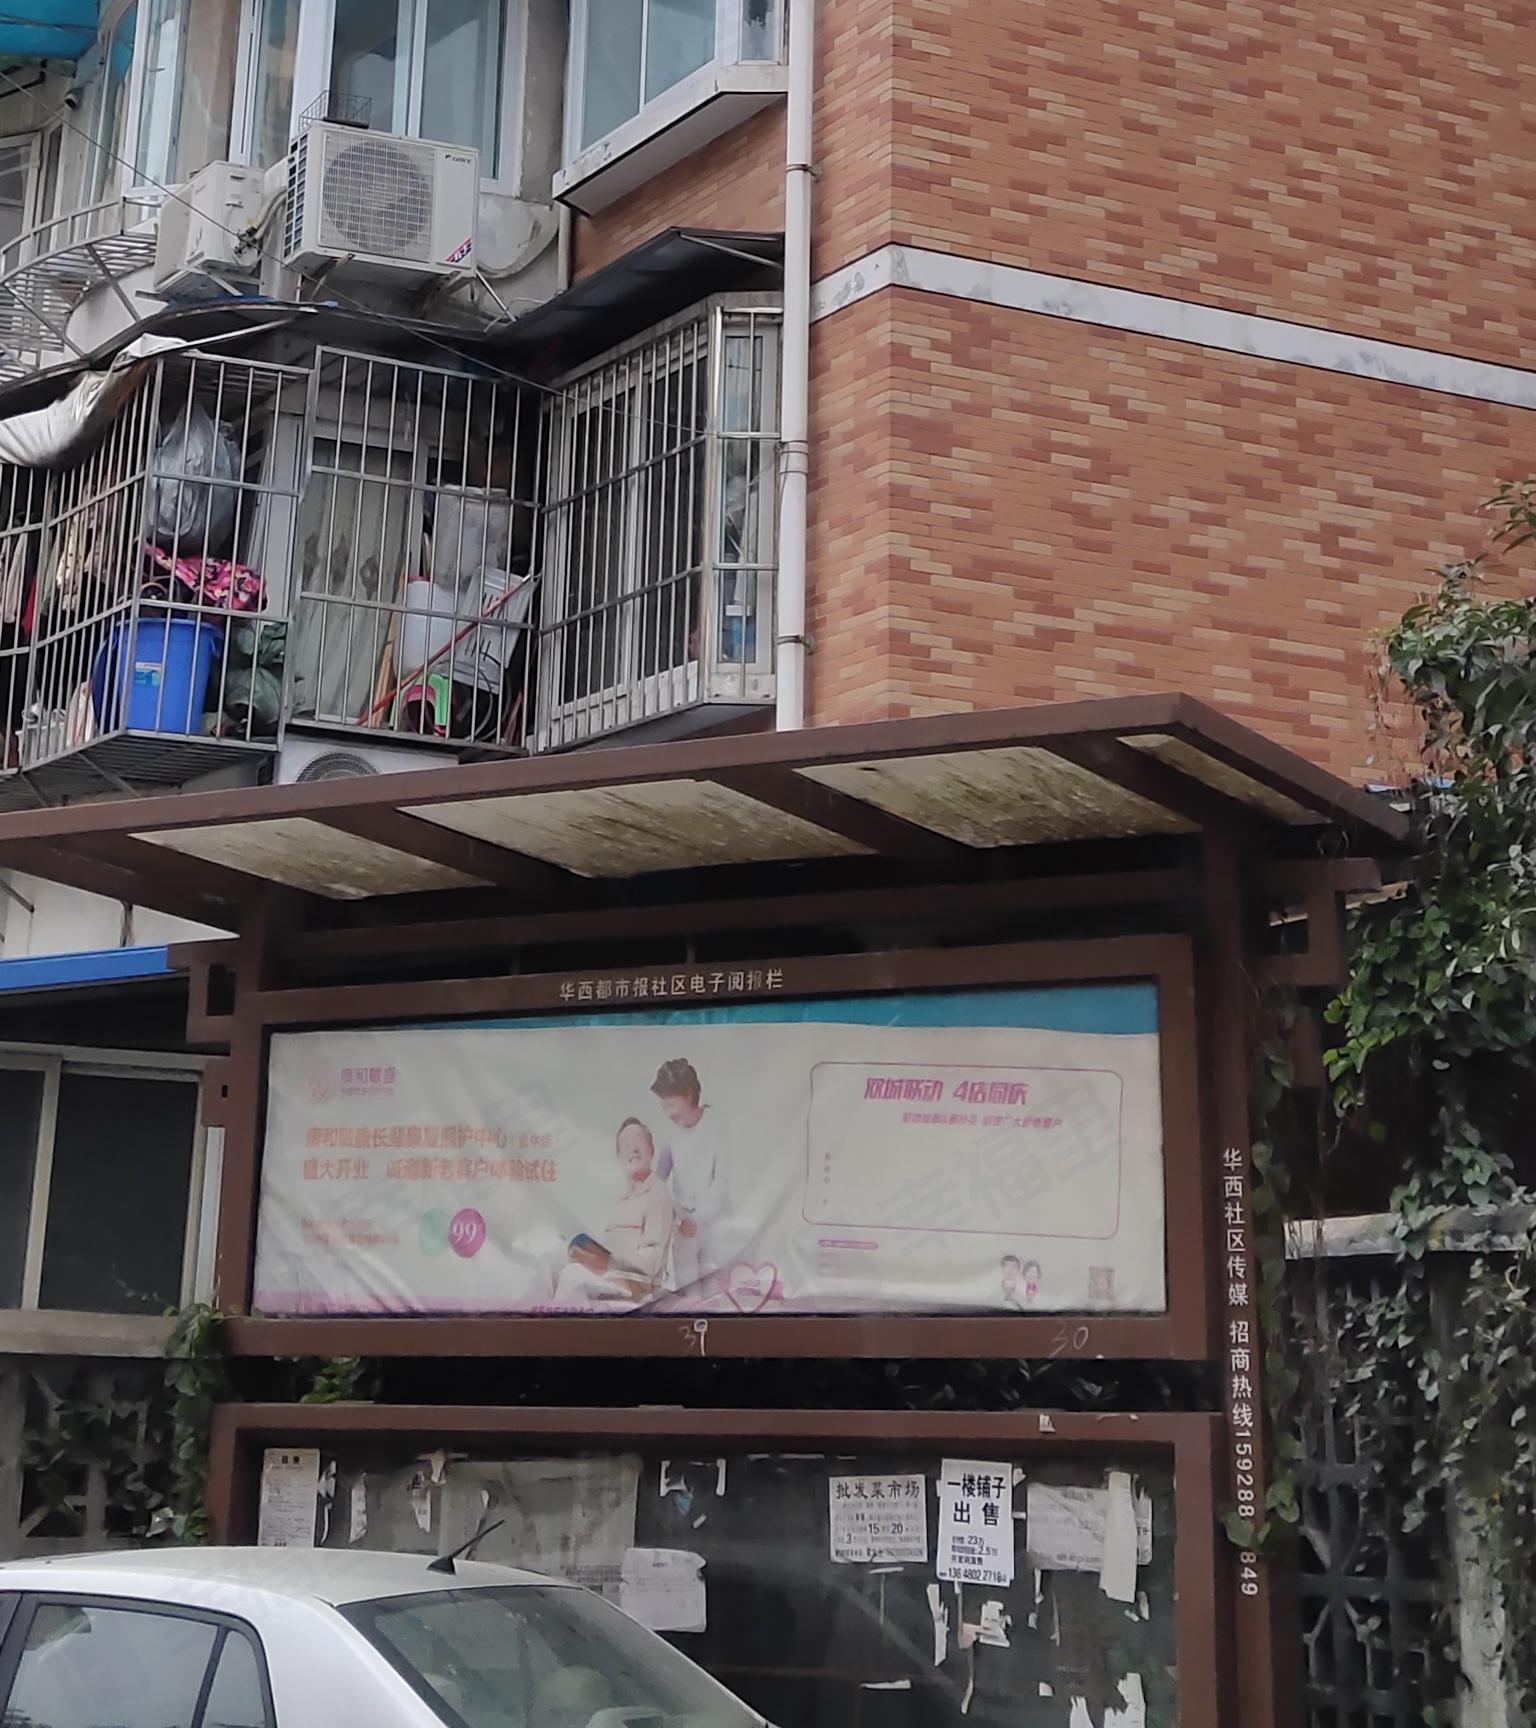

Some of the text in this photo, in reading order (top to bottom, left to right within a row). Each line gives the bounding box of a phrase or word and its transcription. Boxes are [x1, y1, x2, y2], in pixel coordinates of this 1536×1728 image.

[560, 969, 783, 1002] 华西都市报社区电子阅报栏
[450, 1221, 477, 1244] 99
[1223, 1148, 1249, 1306] 华西社区传媒
[836, 1480, 921, 1499] 批发菜市场
[947, 1473, 1006, 1499] 一楼铺子
[953, 1501, 1000, 1526] 出售
